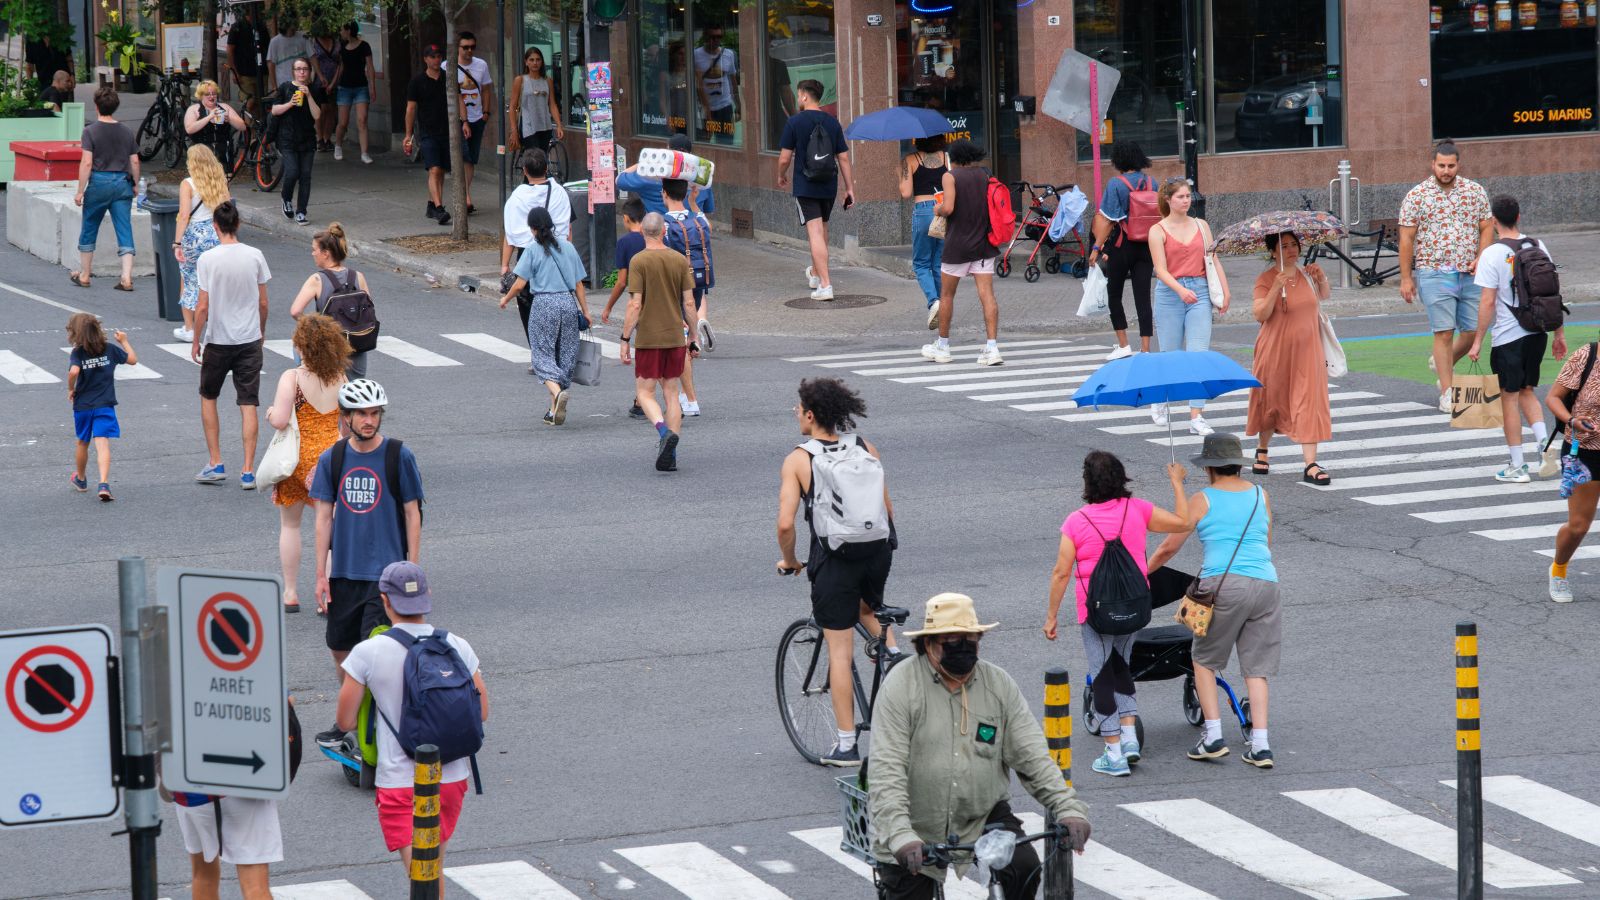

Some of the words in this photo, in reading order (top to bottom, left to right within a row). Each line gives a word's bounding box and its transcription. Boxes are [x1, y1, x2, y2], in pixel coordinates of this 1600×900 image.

[947, 116, 967, 129] oix
[1513, 110, 1544, 123] SOUS
[1548, 107, 1592, 121] MARINS
[345, 477, 376, 490] GOOD
[345, 490, 375, 504] VIBES
[209, 677, 254, 695] ARRÊT
[194, 701, 271, 723] D'AUTOBUS
